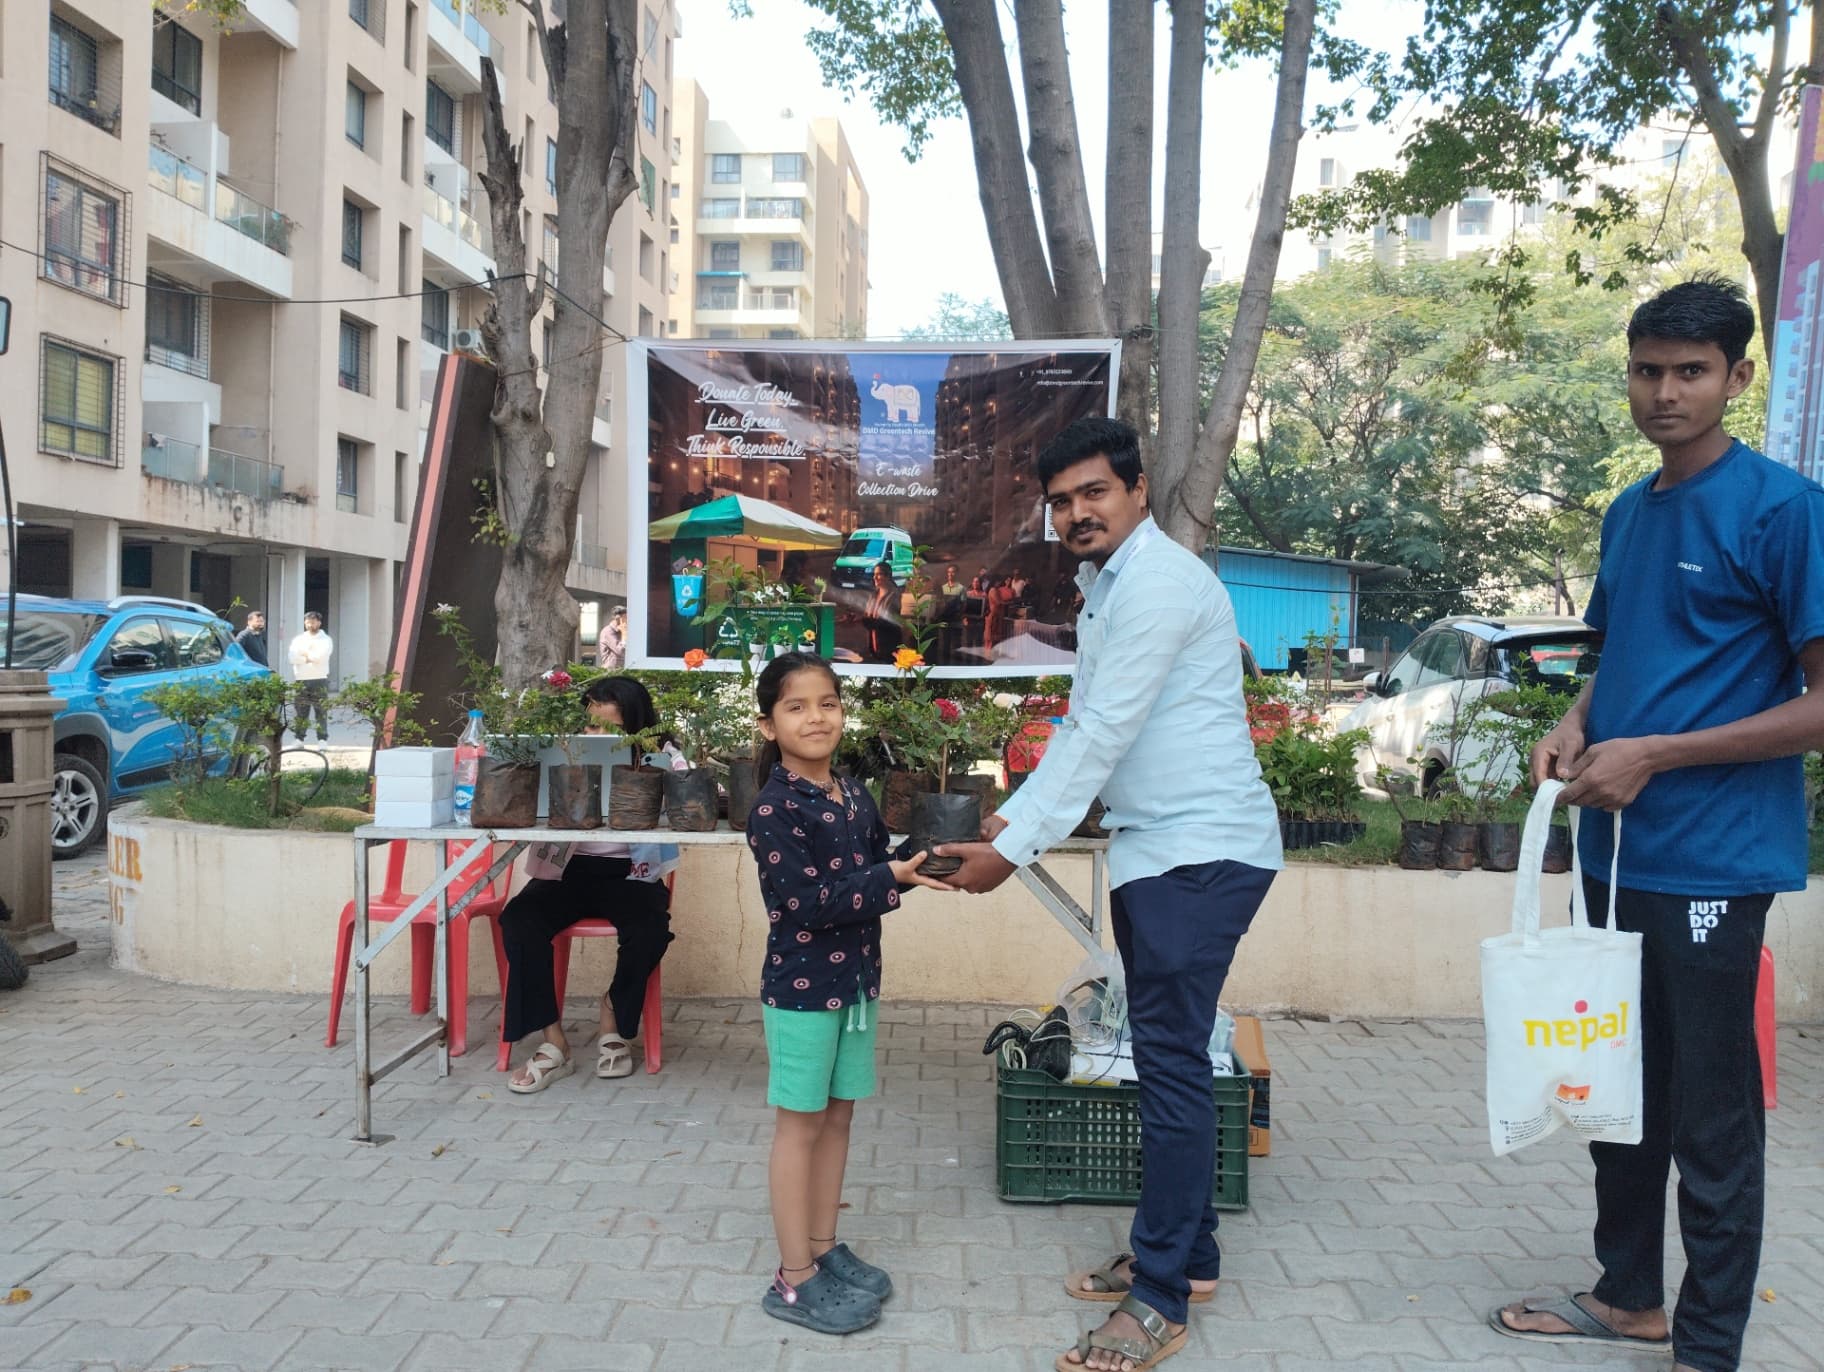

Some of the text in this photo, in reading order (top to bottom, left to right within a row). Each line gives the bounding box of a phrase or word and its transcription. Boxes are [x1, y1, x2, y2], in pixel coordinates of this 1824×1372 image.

[697, 381, 797, 408] Donate Today.
[705, 408, 785, 432] Live Green.
[879, 427, 913, 436] Greentech
[686, 435, 806, 460] Think Responsible.
[857, 481, 939, 498] Collection Drive
[1688, 900, 1729, 915] JUST
[1690, 914, 1719, 929] DO
[1692, 928, 1708, 943] IT
[1522, 1000, 1630, 1053] nepal
